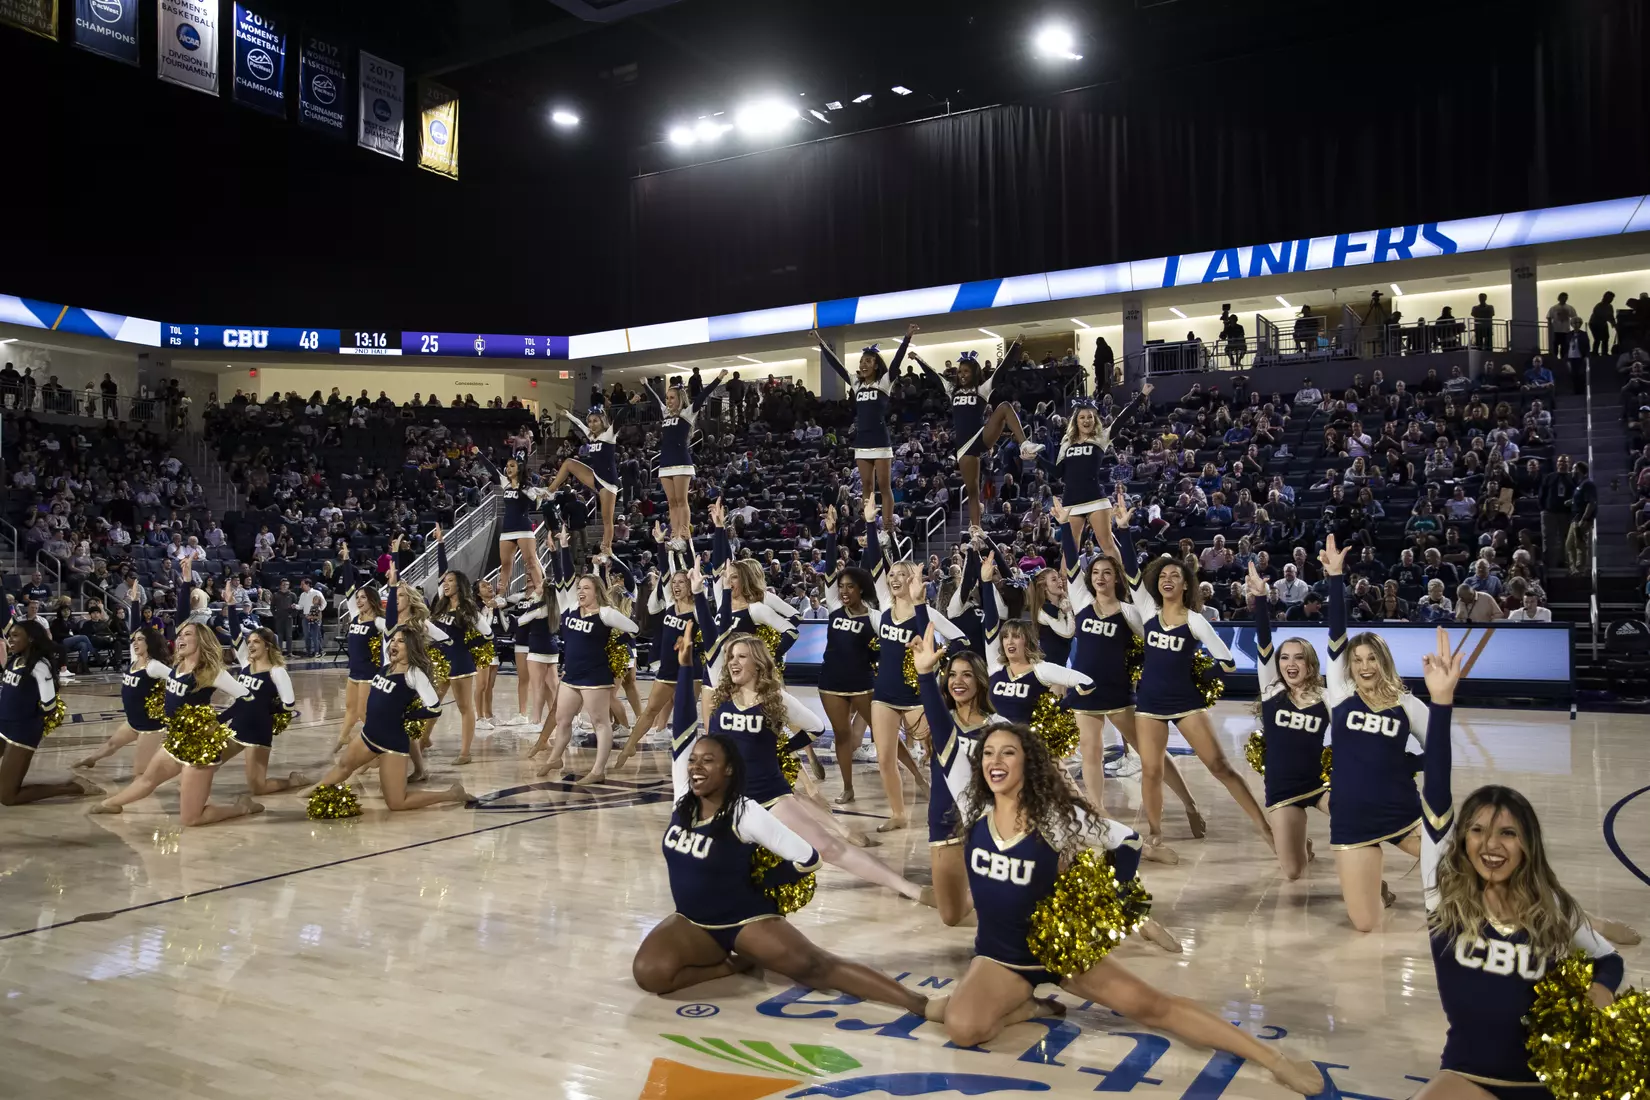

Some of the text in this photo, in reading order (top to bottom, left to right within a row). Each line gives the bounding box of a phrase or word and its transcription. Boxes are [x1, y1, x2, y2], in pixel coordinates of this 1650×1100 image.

[162, 2, 214, 29] BASKETBALL
[245, 10, 276, 30] 2017
[76, 18, 136, 44] CHAMPIONS
[180, 33, 200, 47] NCAA
[240, 21, 278, 44] WOMEN'S
[236, 29, 286, 56] BASKETBALL
[310, 38, 338, 56] 2017
[162, 56, 217, 79] TOURNAMENT
[169, 50, 202, 67] DIVISION
[370, 62, 394, 80] 2017
[236, 76, 284, 100] CHAMPIONS
[304, 110, 344, 129] CHAMPIONS
[170, 326, 199, 336] TOL 3
[222, 329, 269, 348] CBU
[300, 331, 318, 349] 48
[354, 332, 387, 347] 13:16
[170, 337, 199, 346] FLS 0
[420, 335, 438, 353] 25
[547, 348, 550, 357] 0
[857, 391, 878, 401] CBU
[953, 396, 976, 406] CBU
[662, 418, 678, 428] CBU
[1066, 446, 1093, 457] CBU
[504, 490, 518, 499] CBU
[350, 624, 370, 635] CBU
[567, 618, 594, 633] CBU
[664, 615, 687, 631] CBU
[832, 617, 864, 633] CBU
[1081, 618, 1117, 637] CBU
[881, 624, 912, 643] CBU
[1147, 631, 1185, 651] CBU
[237, 675, 263, 690] CBU
[372, 675, 396, 693] CBU
[993, 682, 1029, 698] CBU
[720, 712, 764, 733] CBU
[1275, 709, 1321, 732] CBU
[1346, 710, 1400, 737] CBU
[665, 825, 712, 859] CBU
[971, 848, 1036, 885] CBU
[1454, 936, 1546, 980] CBU
